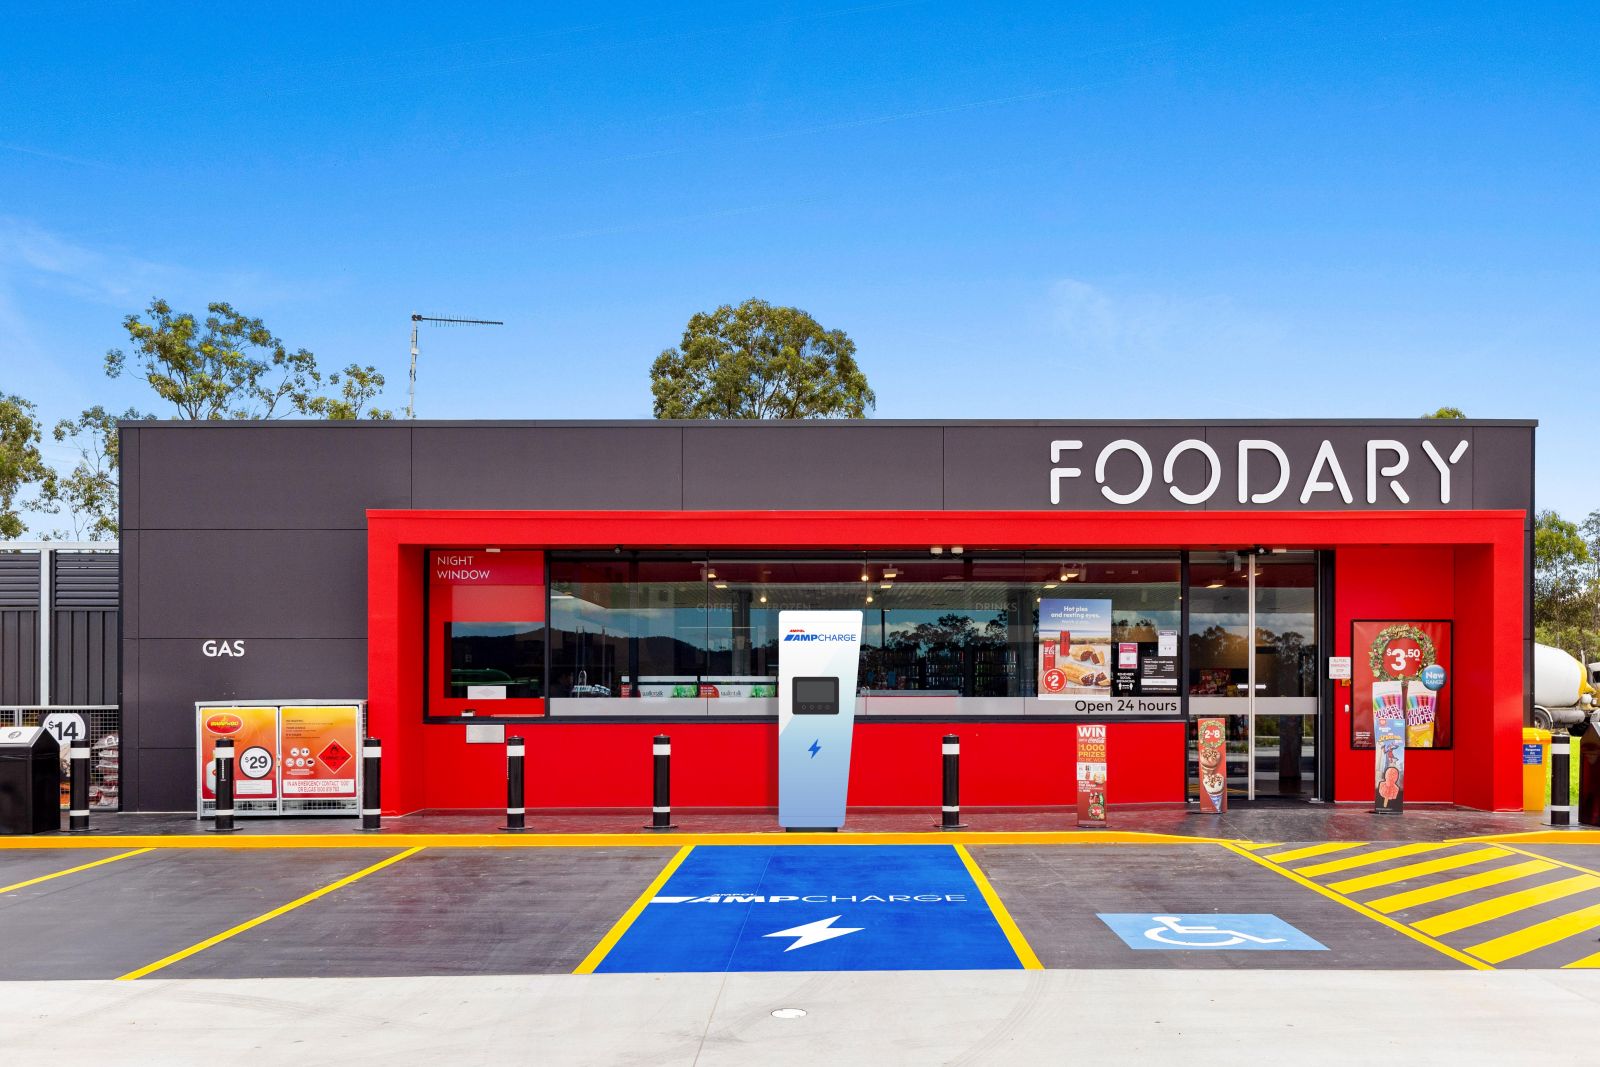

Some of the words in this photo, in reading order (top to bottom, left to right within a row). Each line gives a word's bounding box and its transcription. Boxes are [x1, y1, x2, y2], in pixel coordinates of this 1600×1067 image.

[1050, 439, 1469, 505] FOODARY
[437, 555, 474, 566] NIGHT
[436, 569, 490, 580] WINDOW
[696, 602, 739, 613] COFFEE
[975, 602, 1017, 612] DRINKS
[785, 633, 857, 642] AMPCHARGE
[202, 640, 245, 657] GAS
[1425, 671, 1445, 679] New
[1047, 675, 1059, 687] $2
[1075, 700, 1113, 714] Open
[1117, 700, 1134, 711] 24
[1138, 700, 1177, 711] hours
[48, 721, 79, 741] $14
[1078, 727, 1106, 738] WIN
[244, 755, 268, 769] $29
[687, 894, 967, 904] AMPCHARGE
